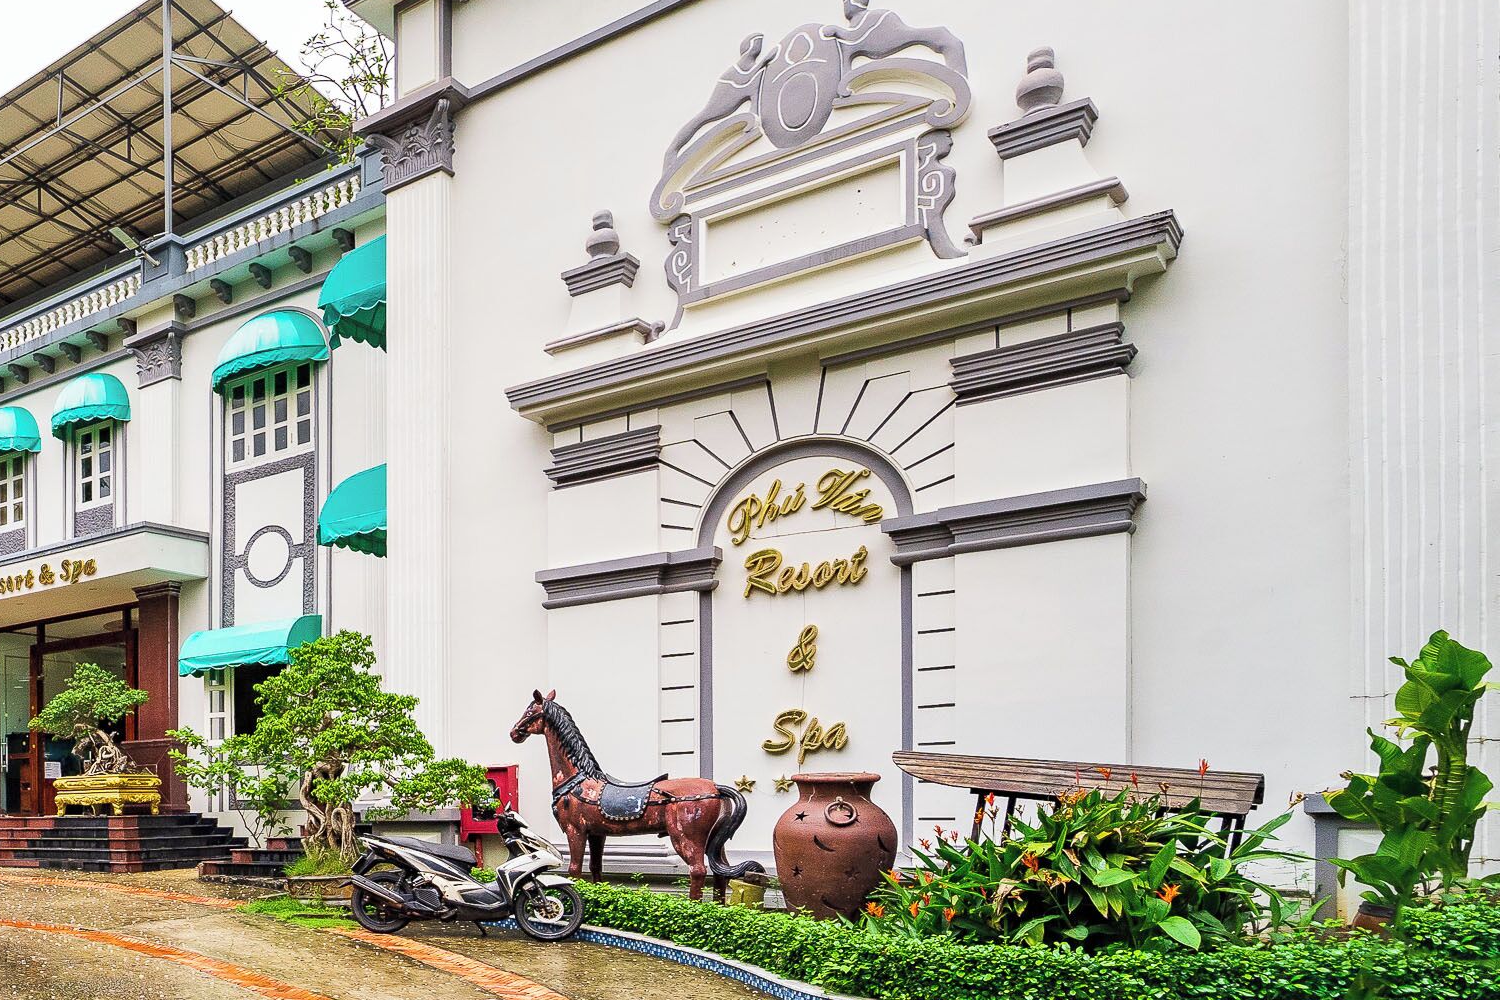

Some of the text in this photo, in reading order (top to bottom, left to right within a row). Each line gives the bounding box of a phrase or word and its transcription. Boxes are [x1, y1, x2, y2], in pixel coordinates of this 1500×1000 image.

[727, 468, 884, 545] Phú Vân
[38, 563, 56, 586] &
[59, 558, 98, 584] Spa
[743, 545, 869, 599] Resort
[787, 624, 819, 673] &
[761, 708, 849, 766] Spa
